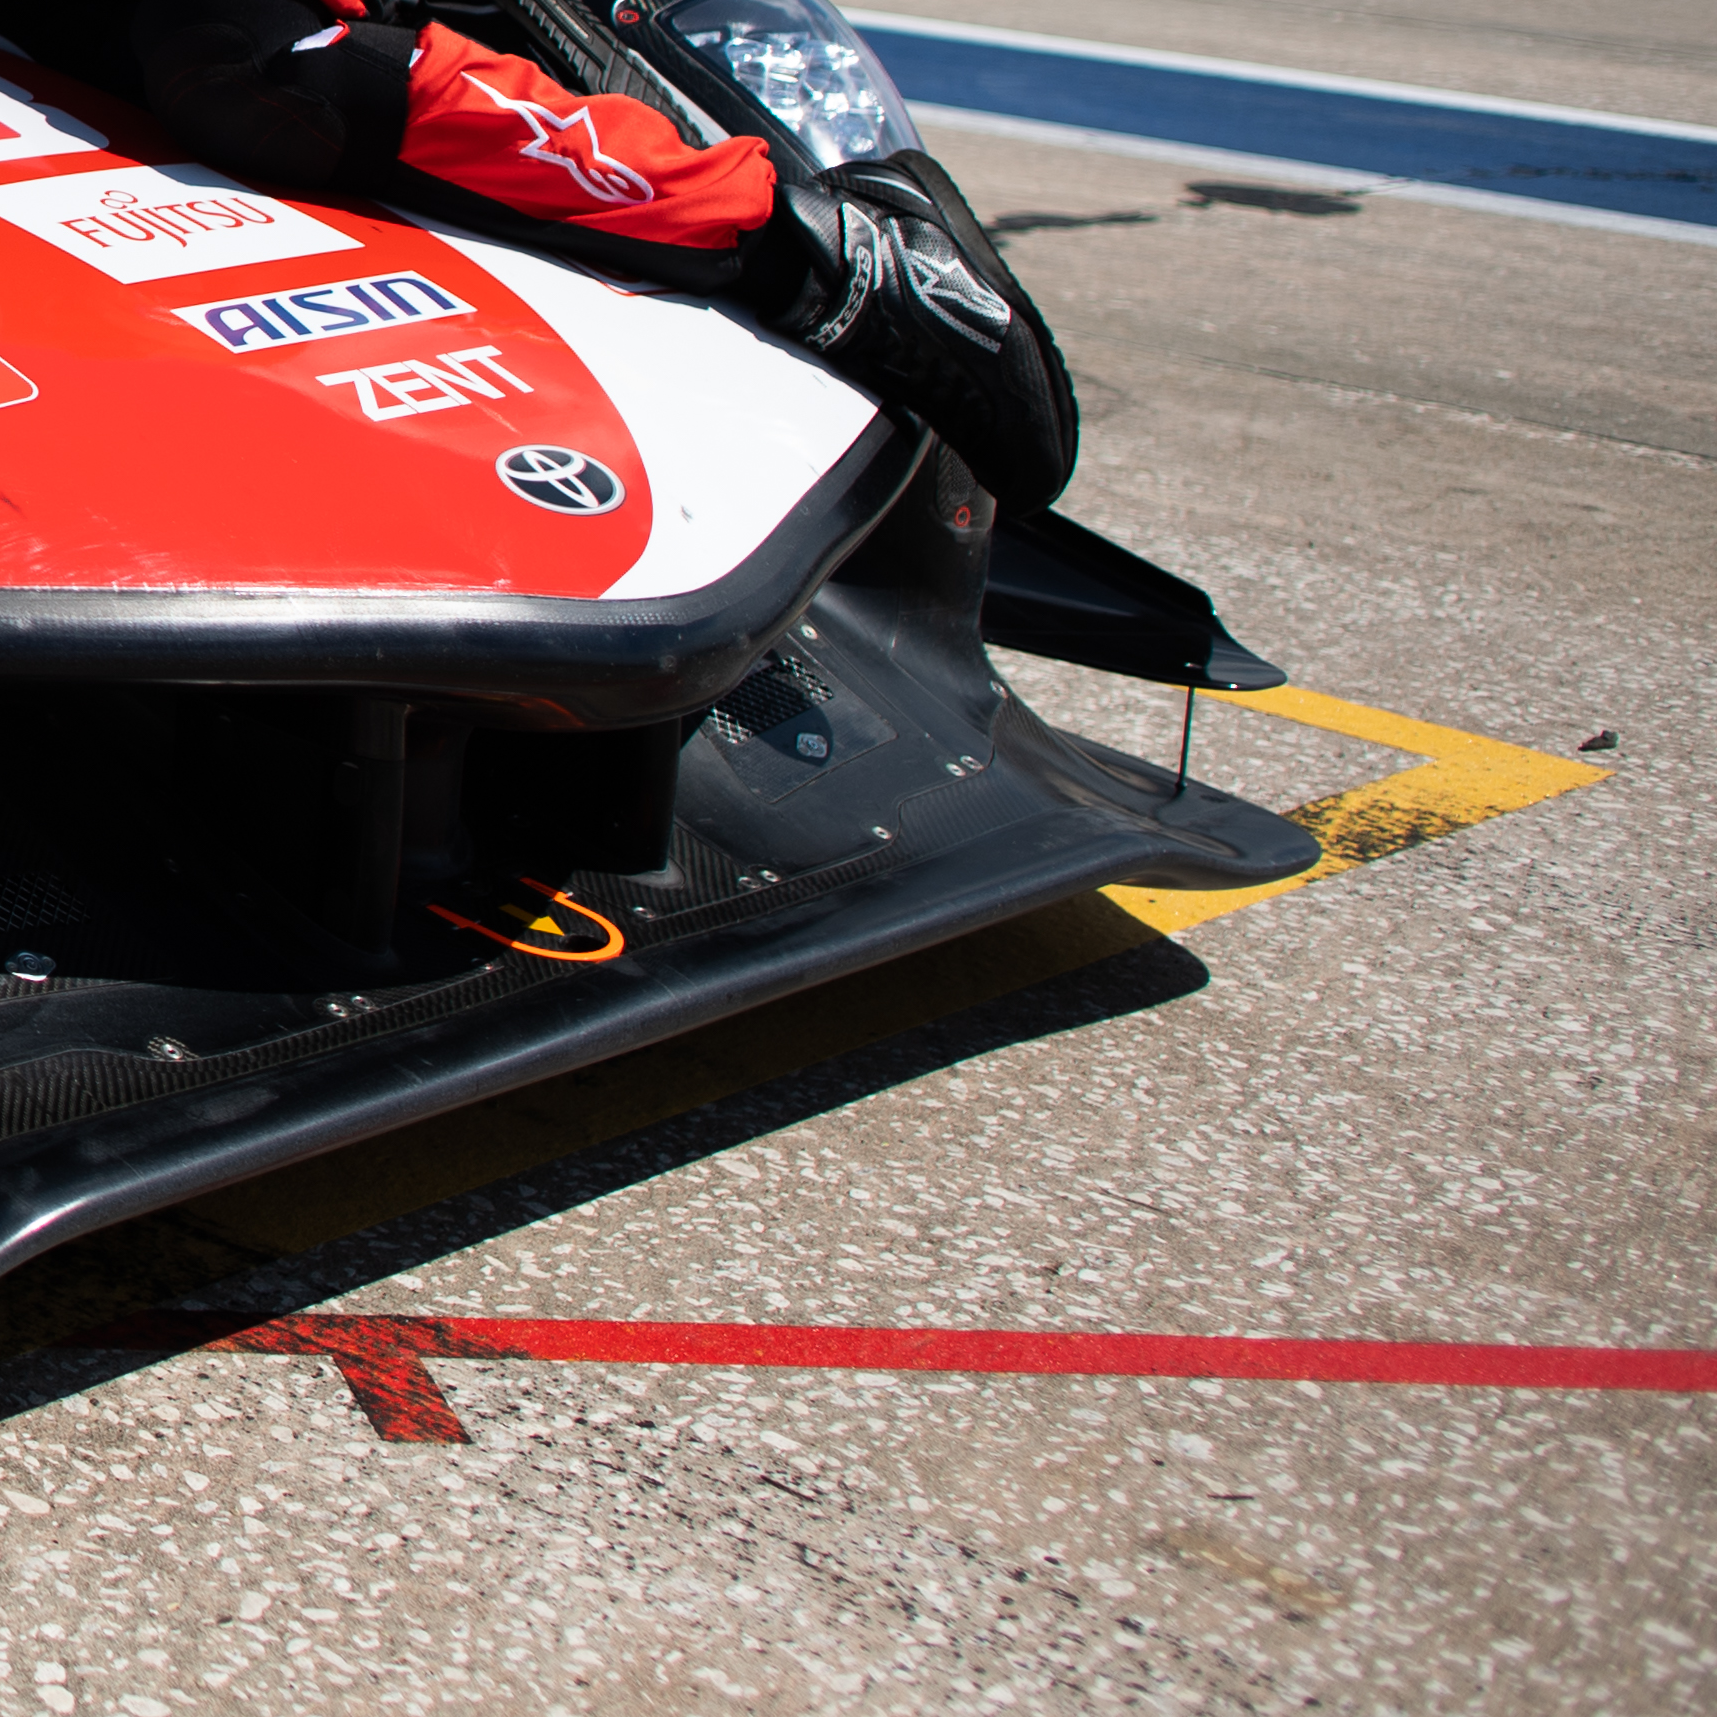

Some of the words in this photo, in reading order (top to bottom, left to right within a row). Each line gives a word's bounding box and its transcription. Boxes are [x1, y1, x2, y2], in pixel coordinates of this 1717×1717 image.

[57, 197, 275, 249] FUJITSU
[205, 278, 457, 348] AISIN
[315, 345, 535, 422] ZENT
